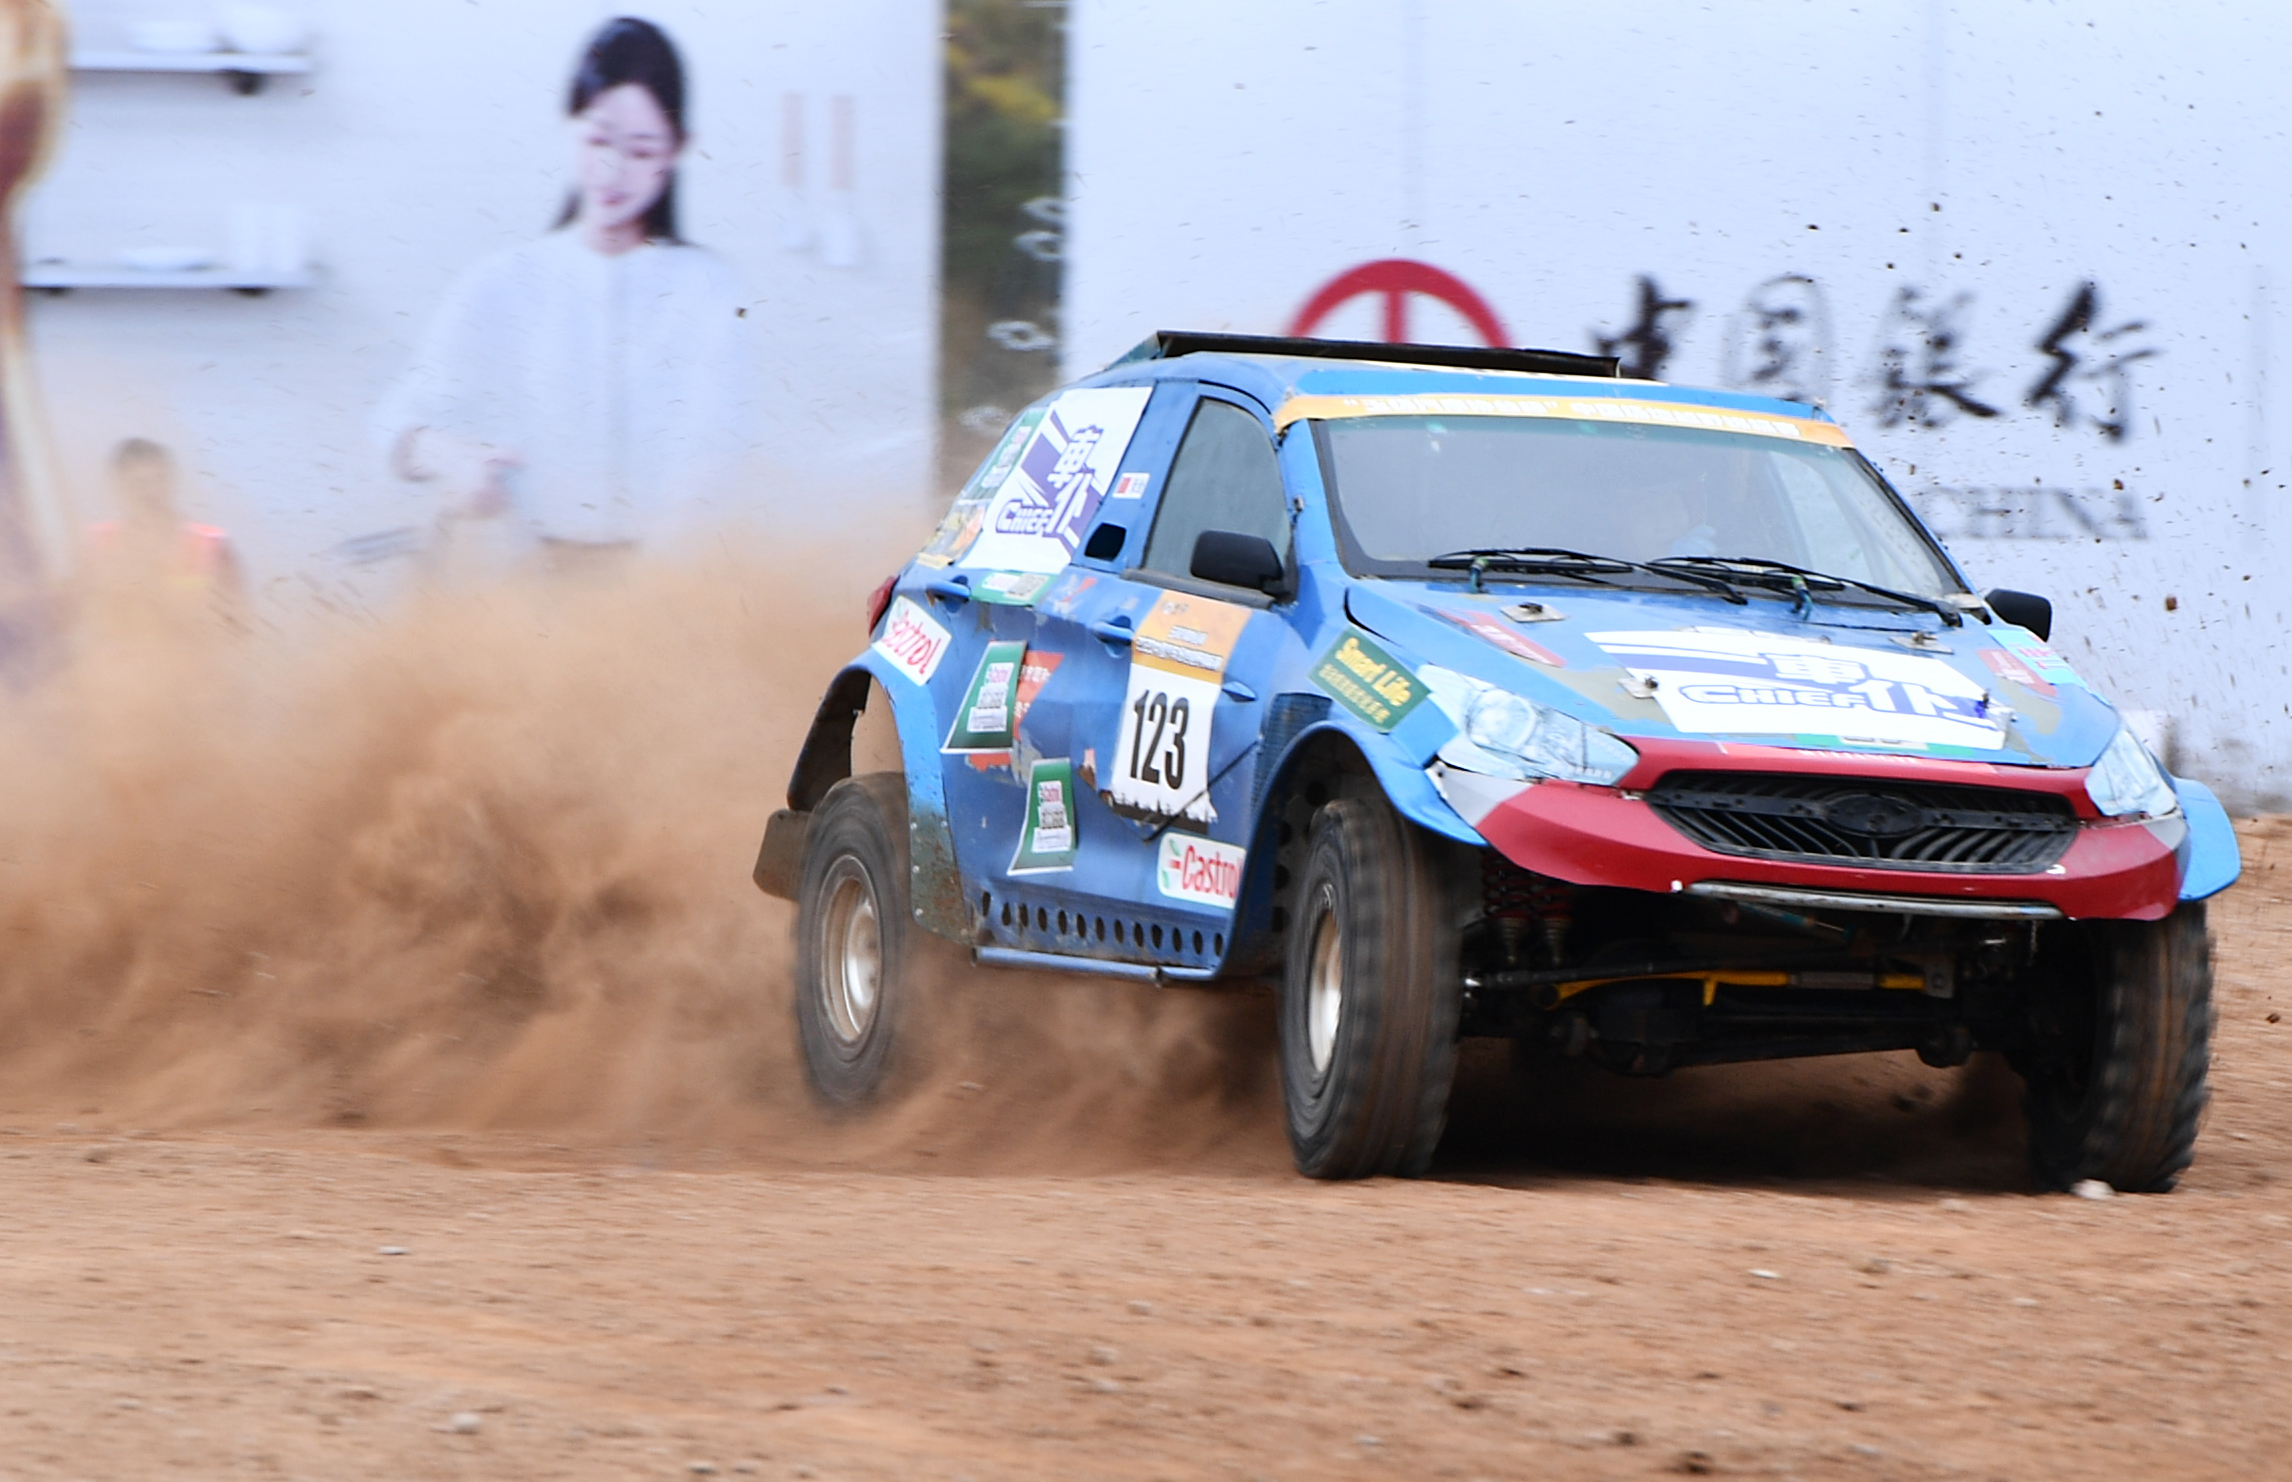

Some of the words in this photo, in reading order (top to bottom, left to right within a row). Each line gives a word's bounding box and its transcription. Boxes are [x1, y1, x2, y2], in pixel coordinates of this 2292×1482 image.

[1335, 636, 1388, 683] Smart
[1372, 669, 1412, 707] Life
[1680, 683, 1868, 710] CHIEF
[1129, 689, 1191, 791] 123
